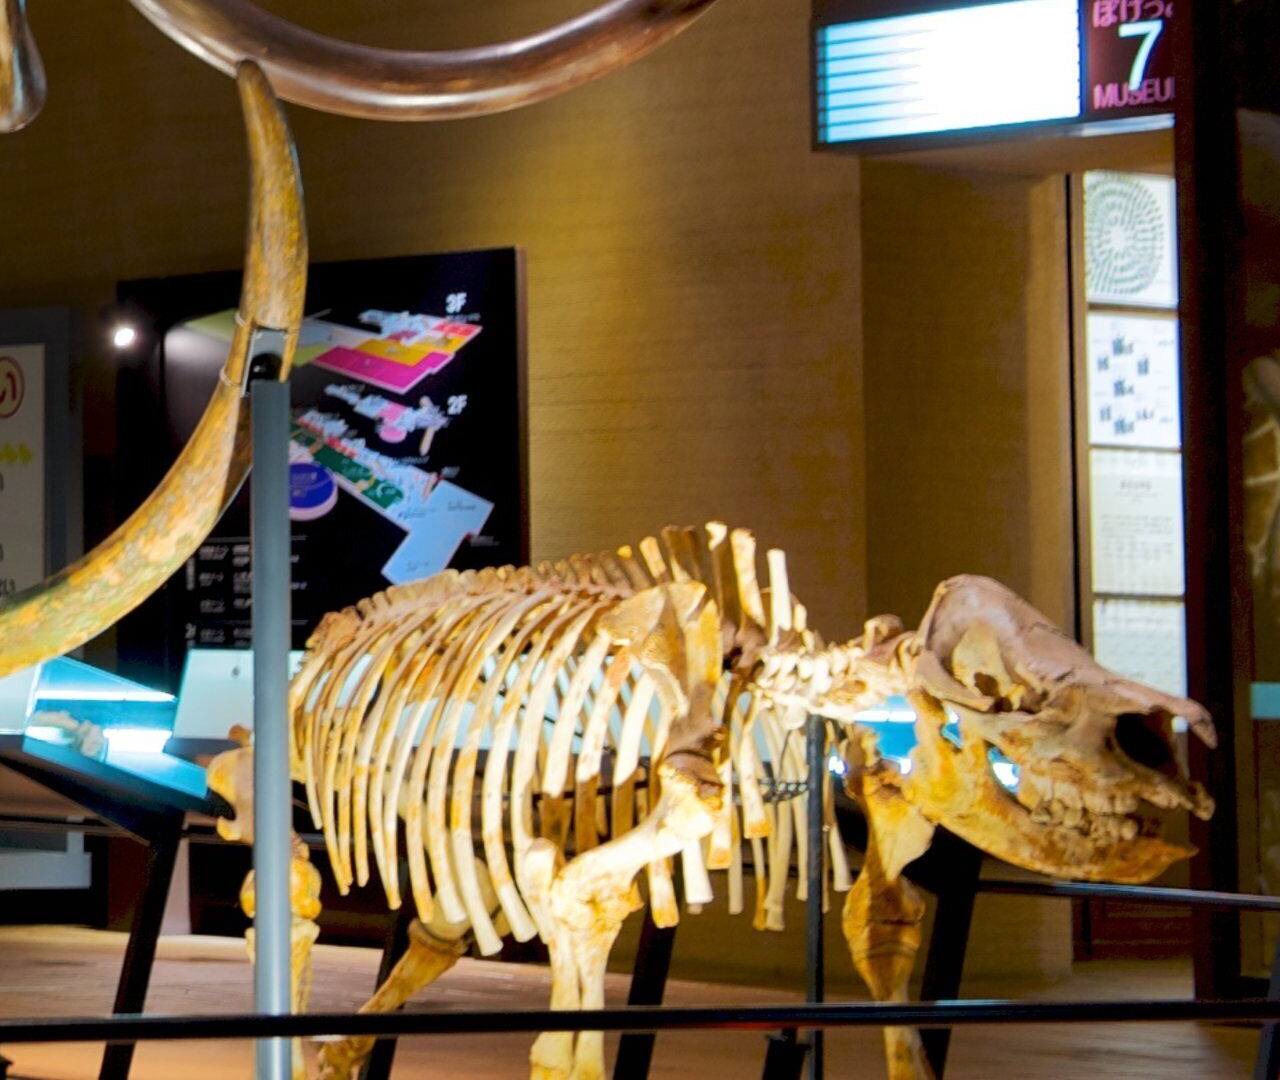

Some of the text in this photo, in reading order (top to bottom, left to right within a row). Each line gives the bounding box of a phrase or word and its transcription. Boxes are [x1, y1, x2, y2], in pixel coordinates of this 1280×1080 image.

[1118, 19, 1163, 91] 7
[445, 292, 468, 314] 3F
[447, 394, 469, 416] 2F
